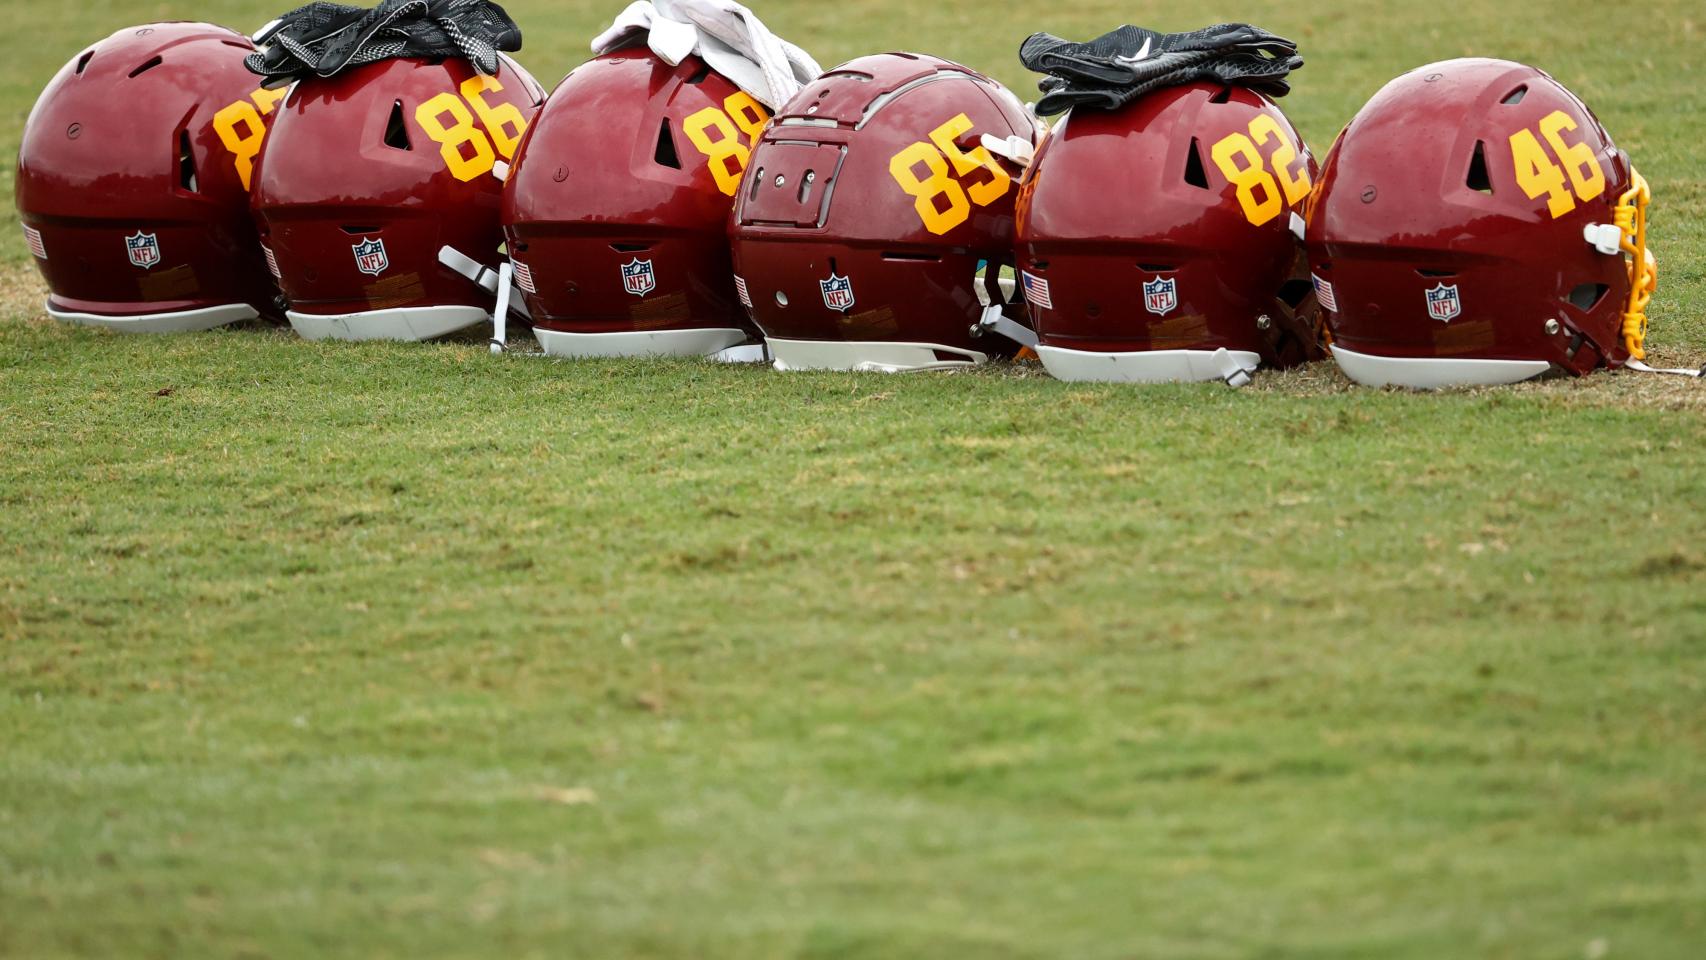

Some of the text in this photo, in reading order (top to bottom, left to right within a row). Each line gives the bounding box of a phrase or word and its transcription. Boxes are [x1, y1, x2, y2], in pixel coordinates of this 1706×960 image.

[415, 75, 530, 183] 86
[1211, 114, 1313, 228] 82
[1508, 110, 1606, 219] 46
[889, 113, 1011, 235] 85
[132, 247, 157, 263] NFL
[360, 252, 384, 270] NFL
[627, 274, 651, 291] NFL
[827, 289, 850, 306] NFL
[1149, 292, 1173, 309] NFL
[1432, 299, 1456, 316] NFL
